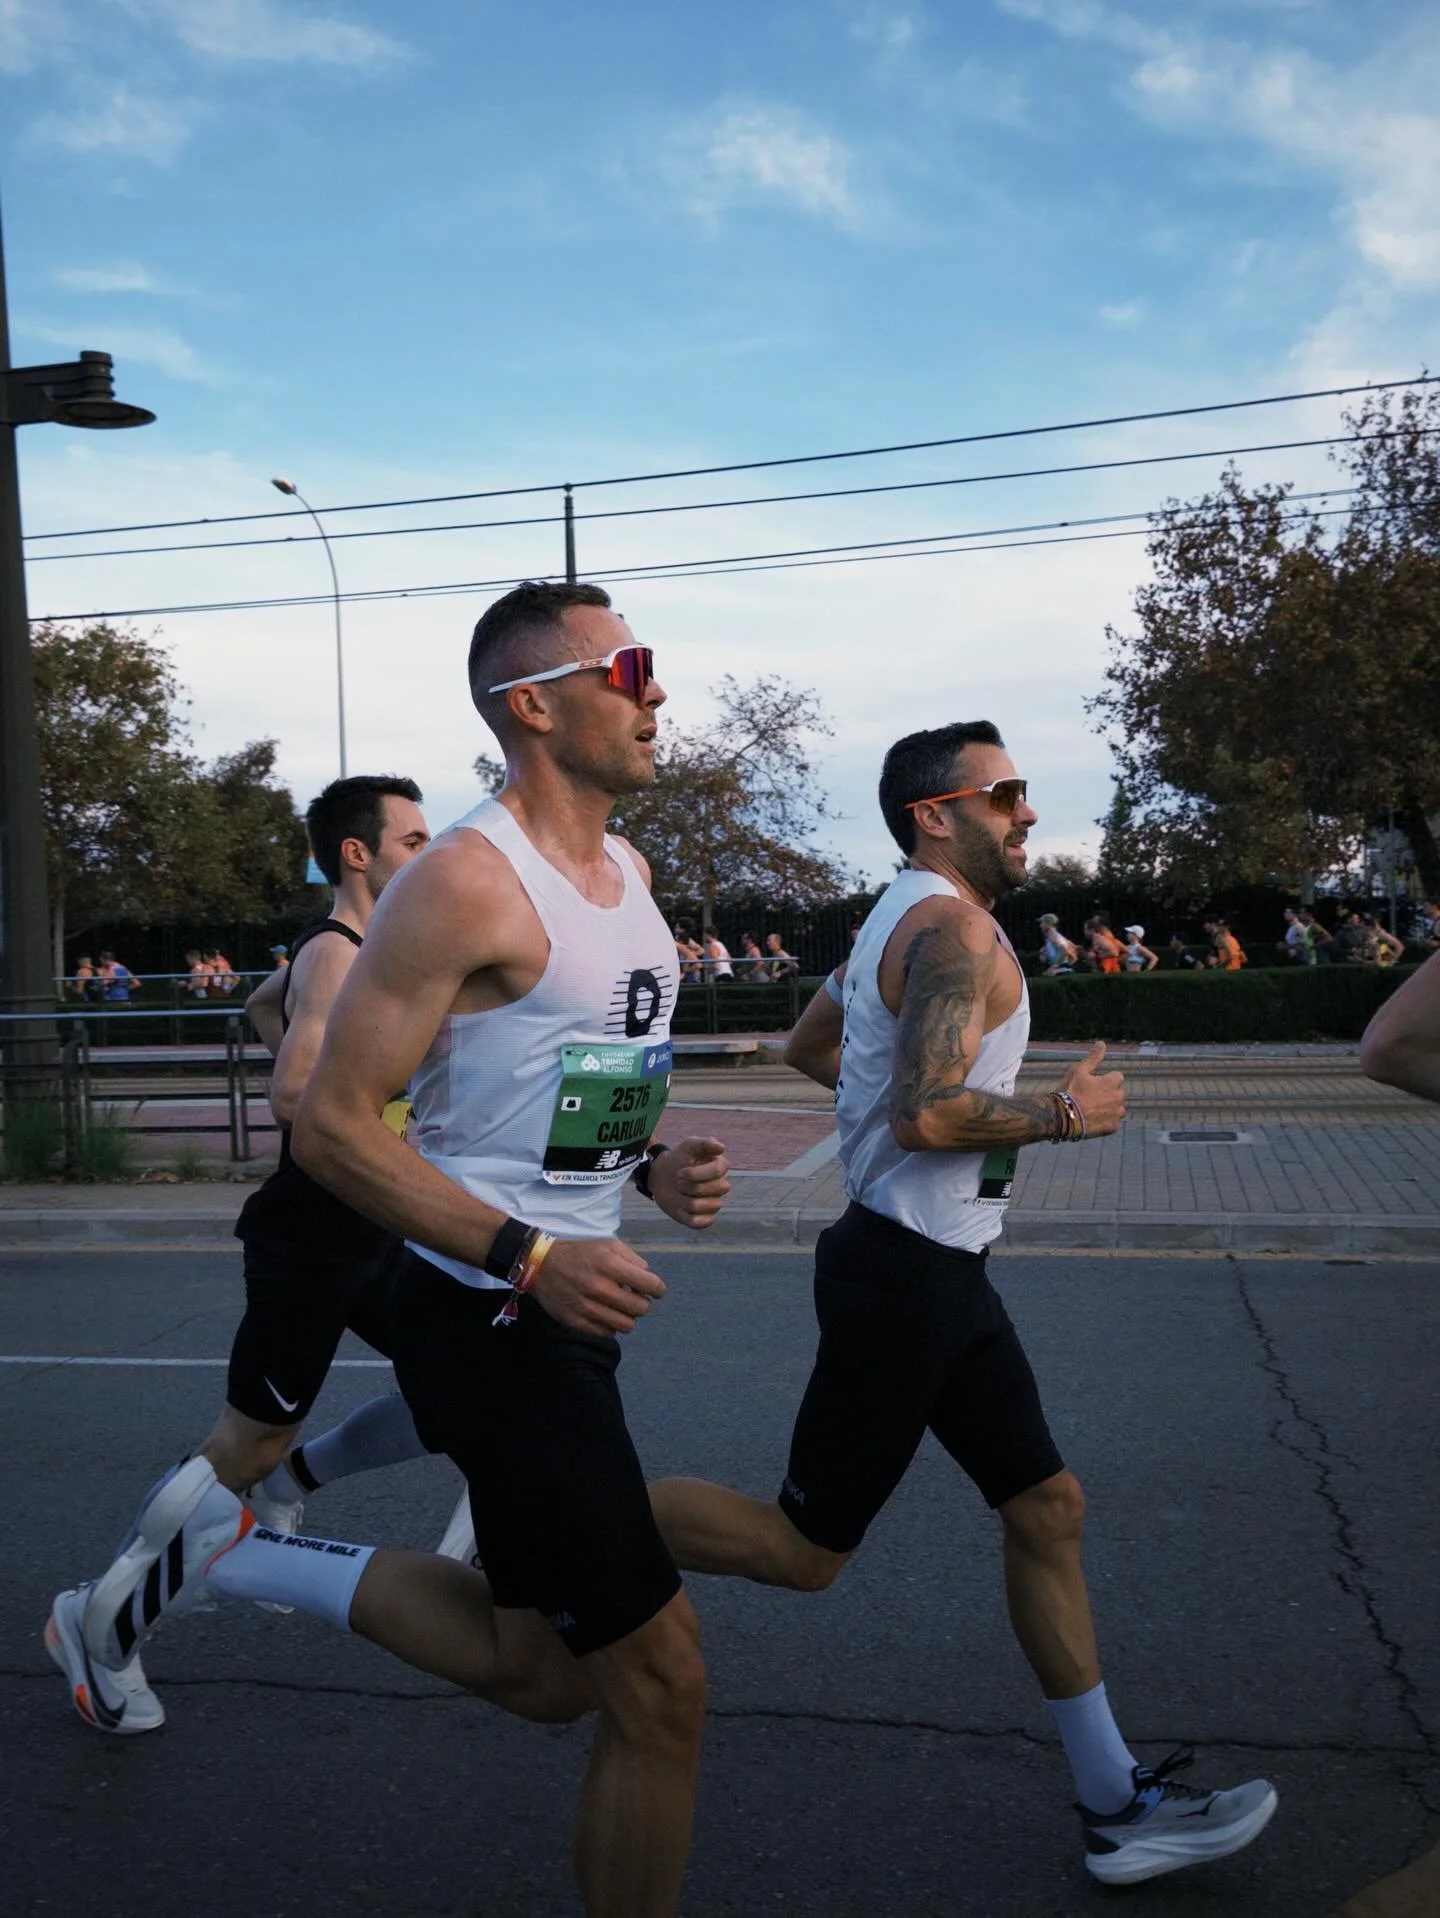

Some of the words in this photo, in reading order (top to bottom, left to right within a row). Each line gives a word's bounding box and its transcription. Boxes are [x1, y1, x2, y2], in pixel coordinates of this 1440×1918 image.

[609, 1084, 651, 1112] 2576
[254, 1528, 284, 1543] ONE
[283, 1536, 328, 1551] MORE
[324, 1543, 362, 1557] MILE
